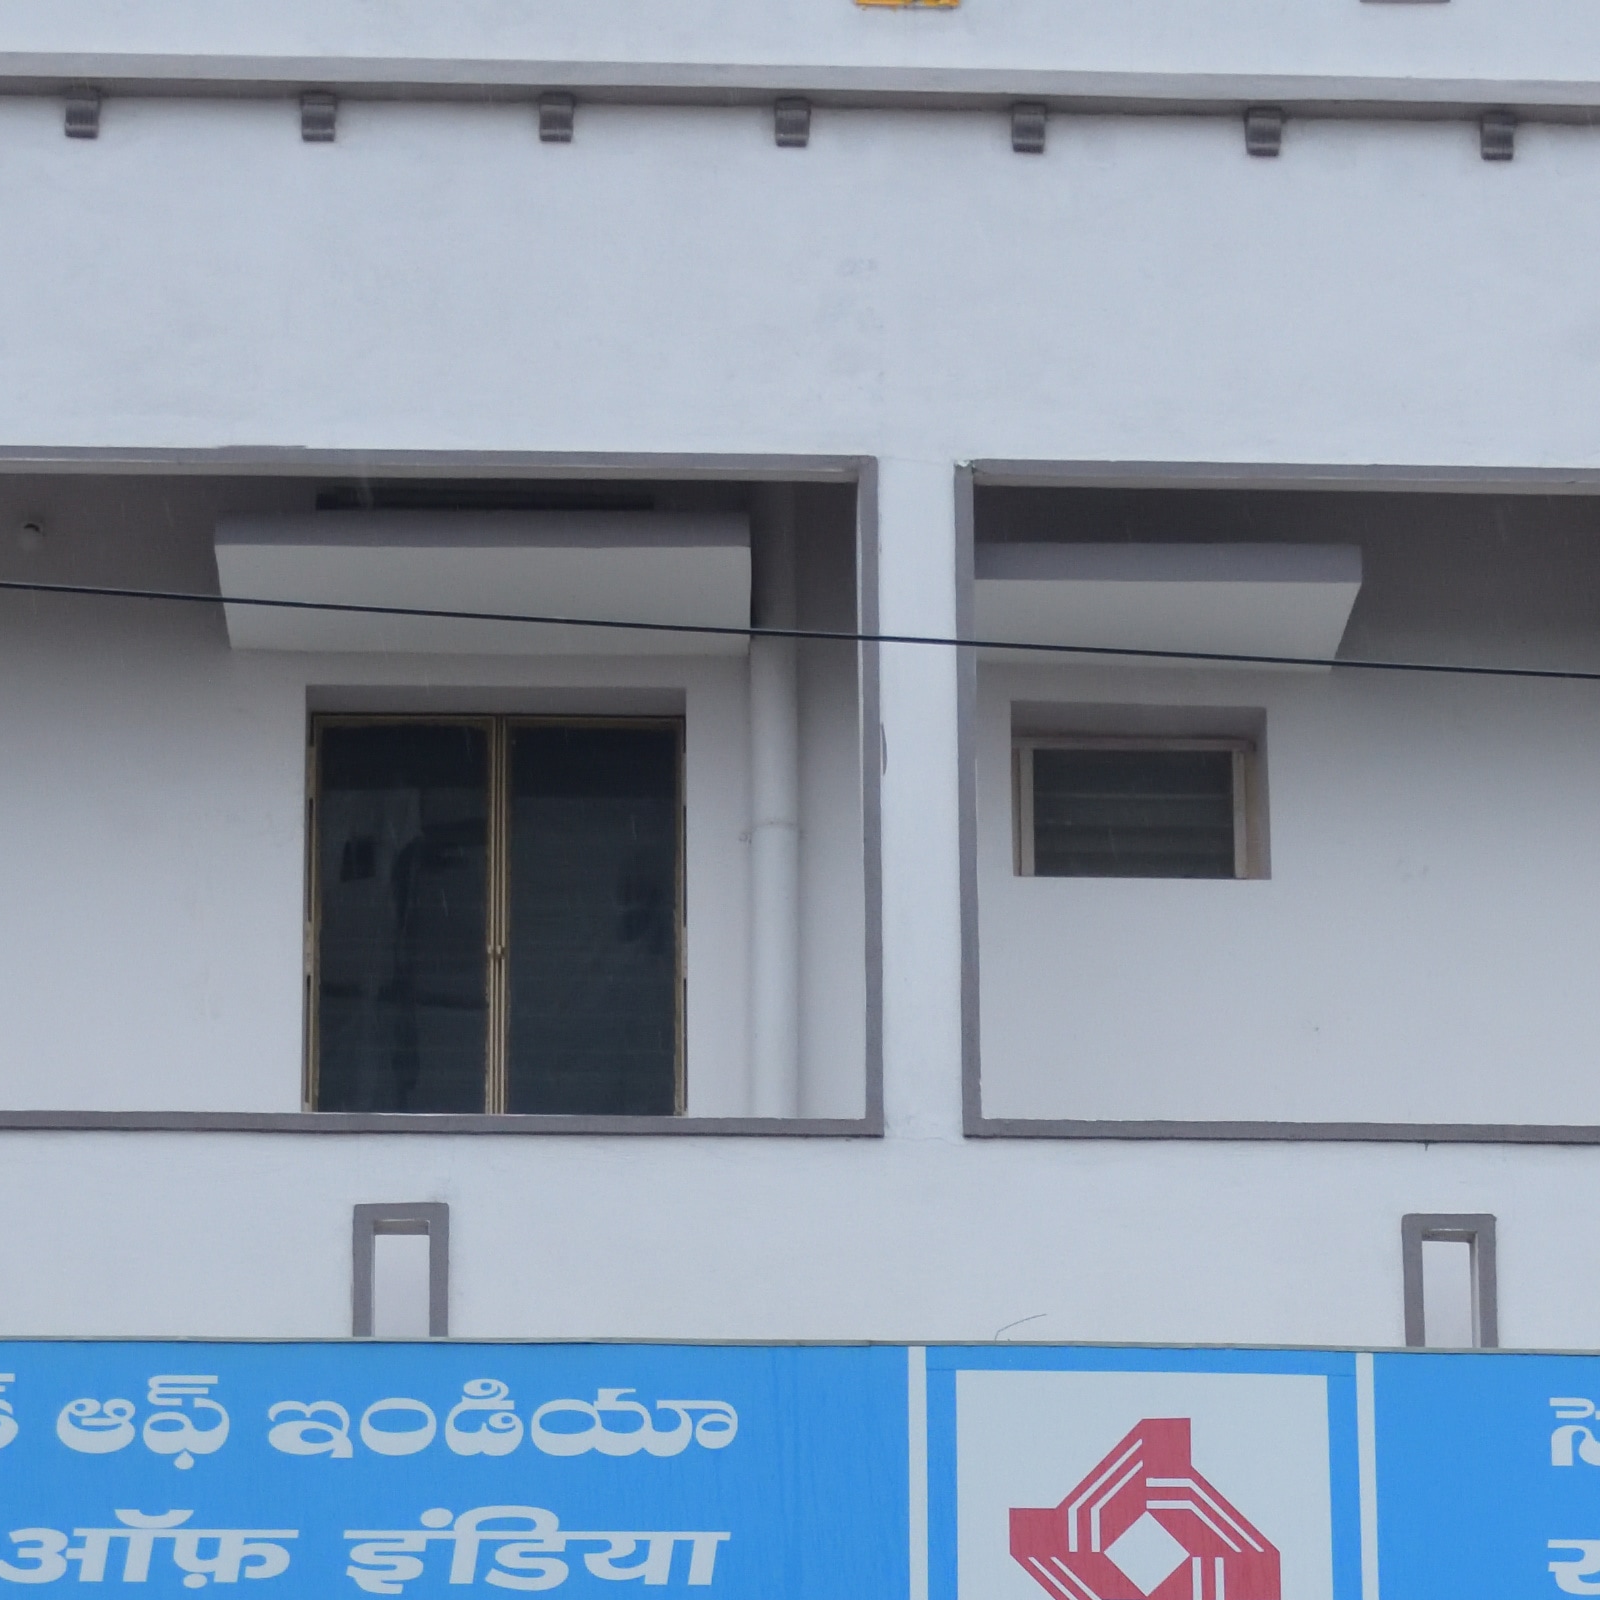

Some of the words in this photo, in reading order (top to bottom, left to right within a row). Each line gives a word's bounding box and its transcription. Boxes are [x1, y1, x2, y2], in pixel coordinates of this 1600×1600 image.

[56, 1373, 231, 1470] ఆఫ్
[266, 1378, 738, 1461] ఇండియా
[344, 1504, 731, 1595] इंडिया
